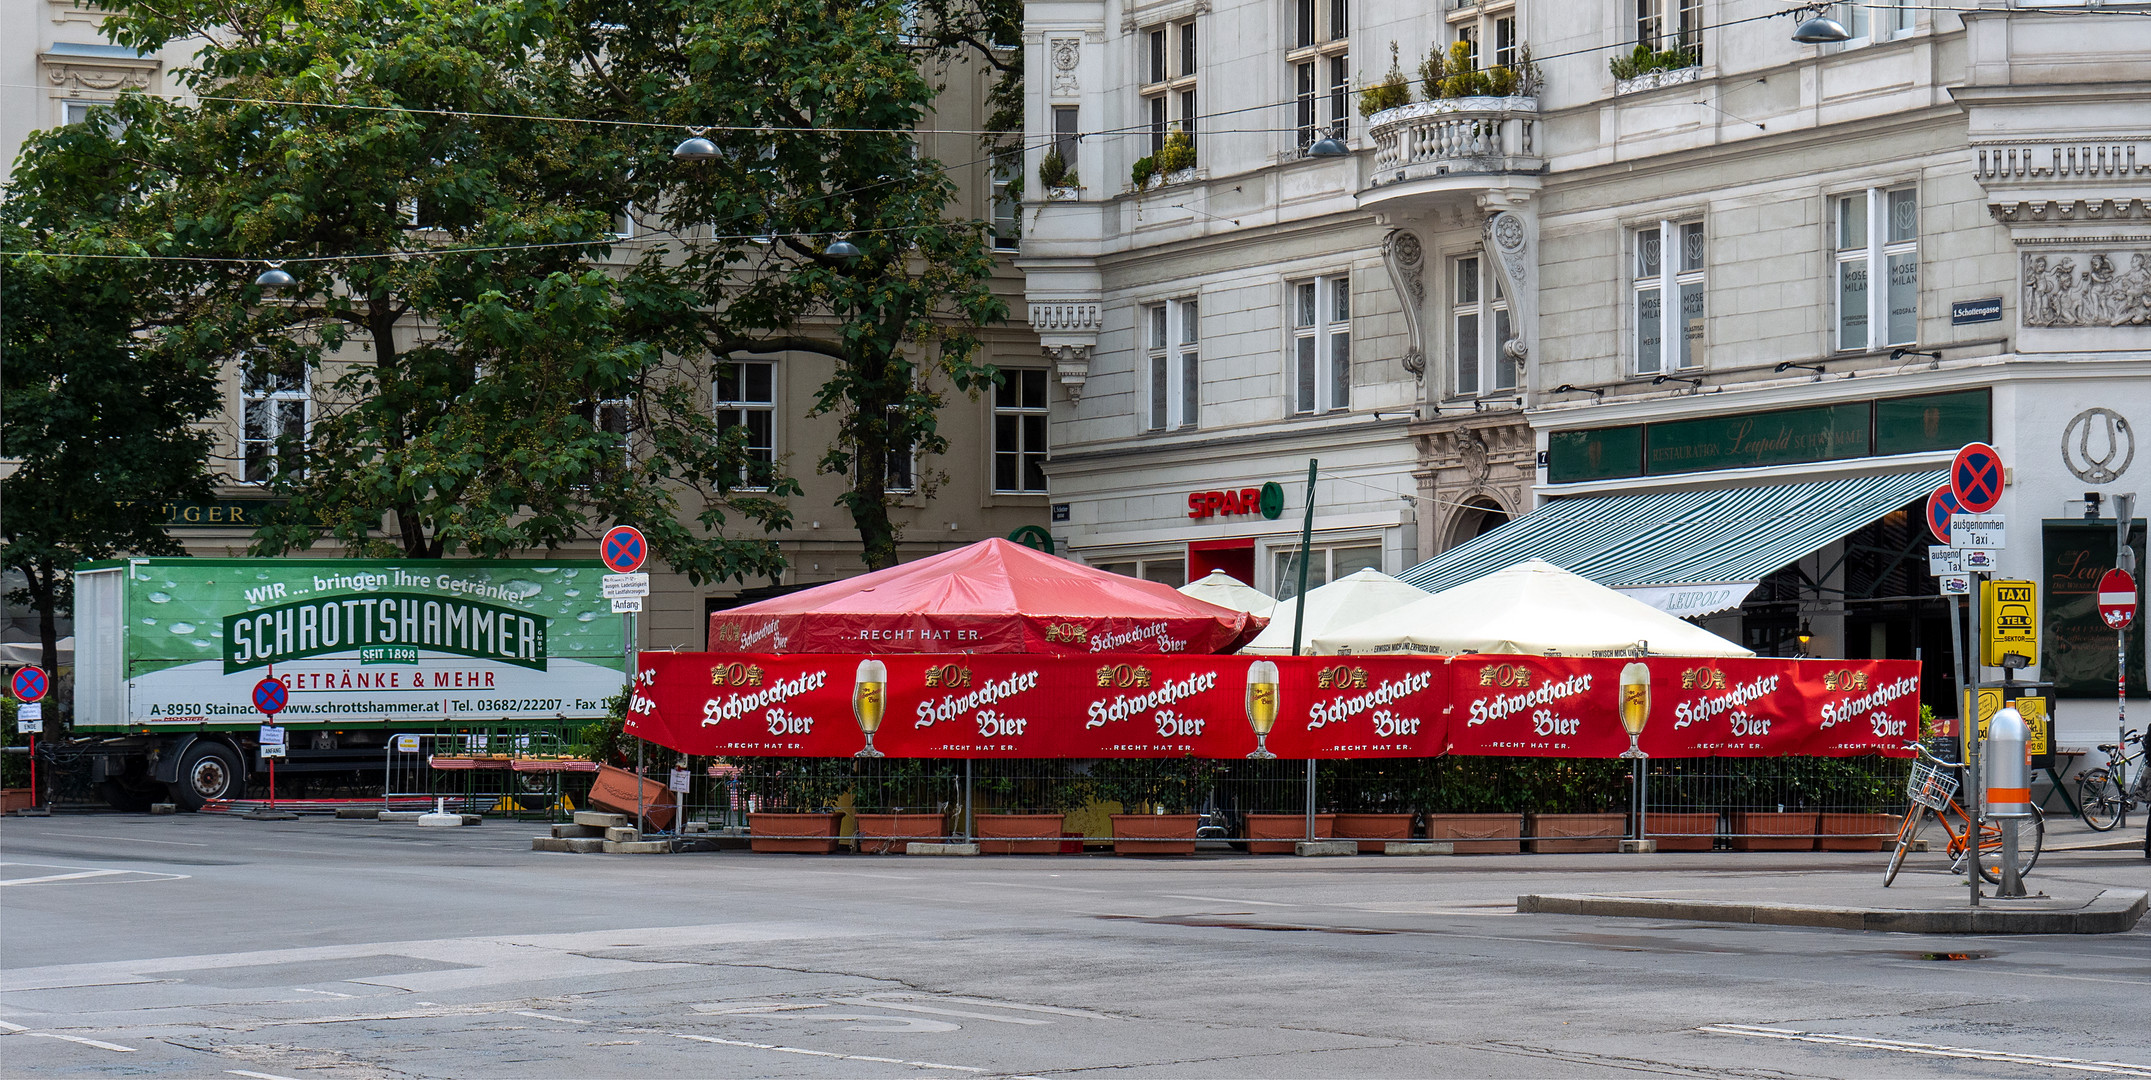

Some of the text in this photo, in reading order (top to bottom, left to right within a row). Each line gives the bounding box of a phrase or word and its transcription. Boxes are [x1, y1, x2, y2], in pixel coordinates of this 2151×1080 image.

[1845, 270, 1867, 281] MOSE
[1641, 299, 1660, 310] MOSE
[1684, 292, 1703, 304] MOSE
[1641, 309, 1660, 320] MILA
[1725, 419, 1793, 460] Leupold
[1794, 429, 1864, 450] SCHWMME
[1188, 488, 1261, 518] SPAR
[1953, 519, 2004, 532] ausgenommen
[1970, 533, 1988, 544] Taxi
[1931, 550, 1959, 561] ausgeno
[245, 582, 288, 605] WIR
[314, 573, 388, 592] bringen
[394, 570, 431, 588] Ihre
[436, 575, 525, 605] Getränke!
[1666, 590, 1731, 611] LEUPOLD
[1999, 588, 2029, 601] TAXI
[234, 598, 537, 665] SCHROTTSHAMMER
[2006, 616, 2024, 625] TEL
[921, 630, 951, 640] HAT
[958, 631, 983, 641] ER.
[1090, 622, 1168, 653] Schwechater
[1157, 635, 1187, 653] Bier
[363, 647, 416, 662] SEIT 1898
[1614, 649, 1626, 657] MICH
[281, 669, 495, 689] GETRÄNKE & MEHR
[150, 703, 201, 716] A-8950
[206, 702, 263, 715] Stainac
[452, 700, 473, 712] Tel.
[477, 699, 562, 713] 03682/22207
[575, 699, 597, 711] Fax
[629, 689, 657, 716] ier
[701, 669, 828, 728] Schwechater
[914, 670, 1039, 729] Schwechater
[1086, 670, 1218, 730] Schwechater
[1307, 670, 1432, 731] Schwechater
[1467, 672, 1594, 728] Schwechater
[1674, 674, 1780, 731] Schwechater
[1820, 675, 1919, 731] Schwechater
[766, 708, 816, 736] Bier
[976, 709, 1028, 738] Bier
[1155, 709, 1206, 738] Bier
[1372, 710, 1421, 738] Bier
[1533, 709, 1580, 737] Bier
[1730, 710, 1771, 738] Bier
[1870, 711, 1908, 738] Bier
